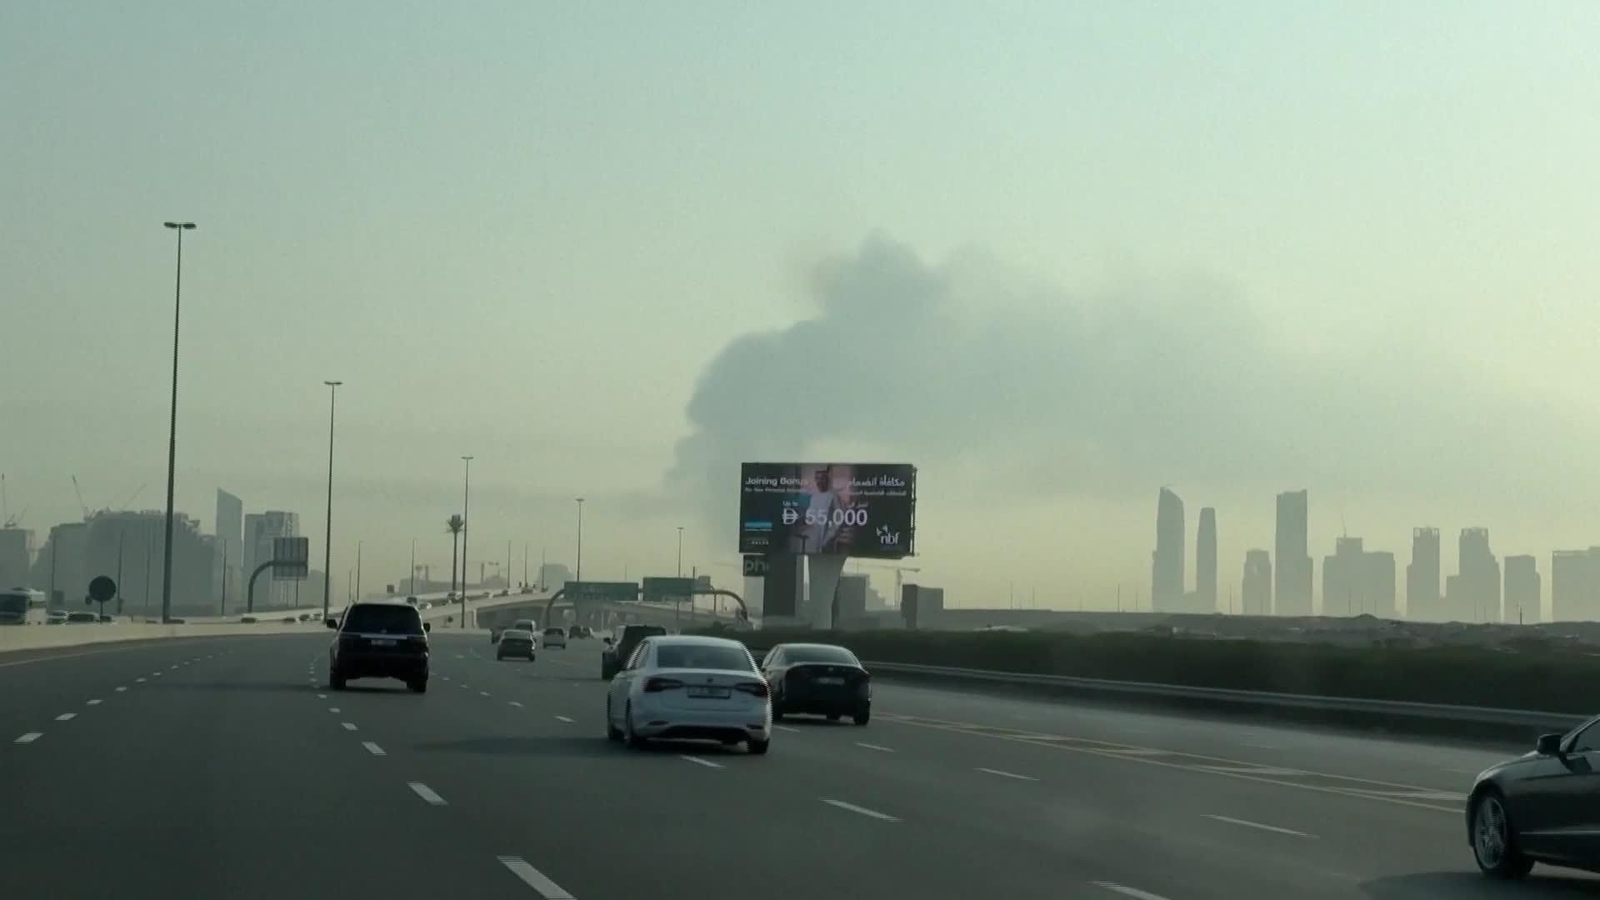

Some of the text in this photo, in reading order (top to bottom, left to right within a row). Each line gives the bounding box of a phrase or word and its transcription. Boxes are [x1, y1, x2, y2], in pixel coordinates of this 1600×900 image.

[745, 477, 778, 487] Joining
[805, 508, 868, 528] 55,000
[880, 532, 900, 545] nbf
